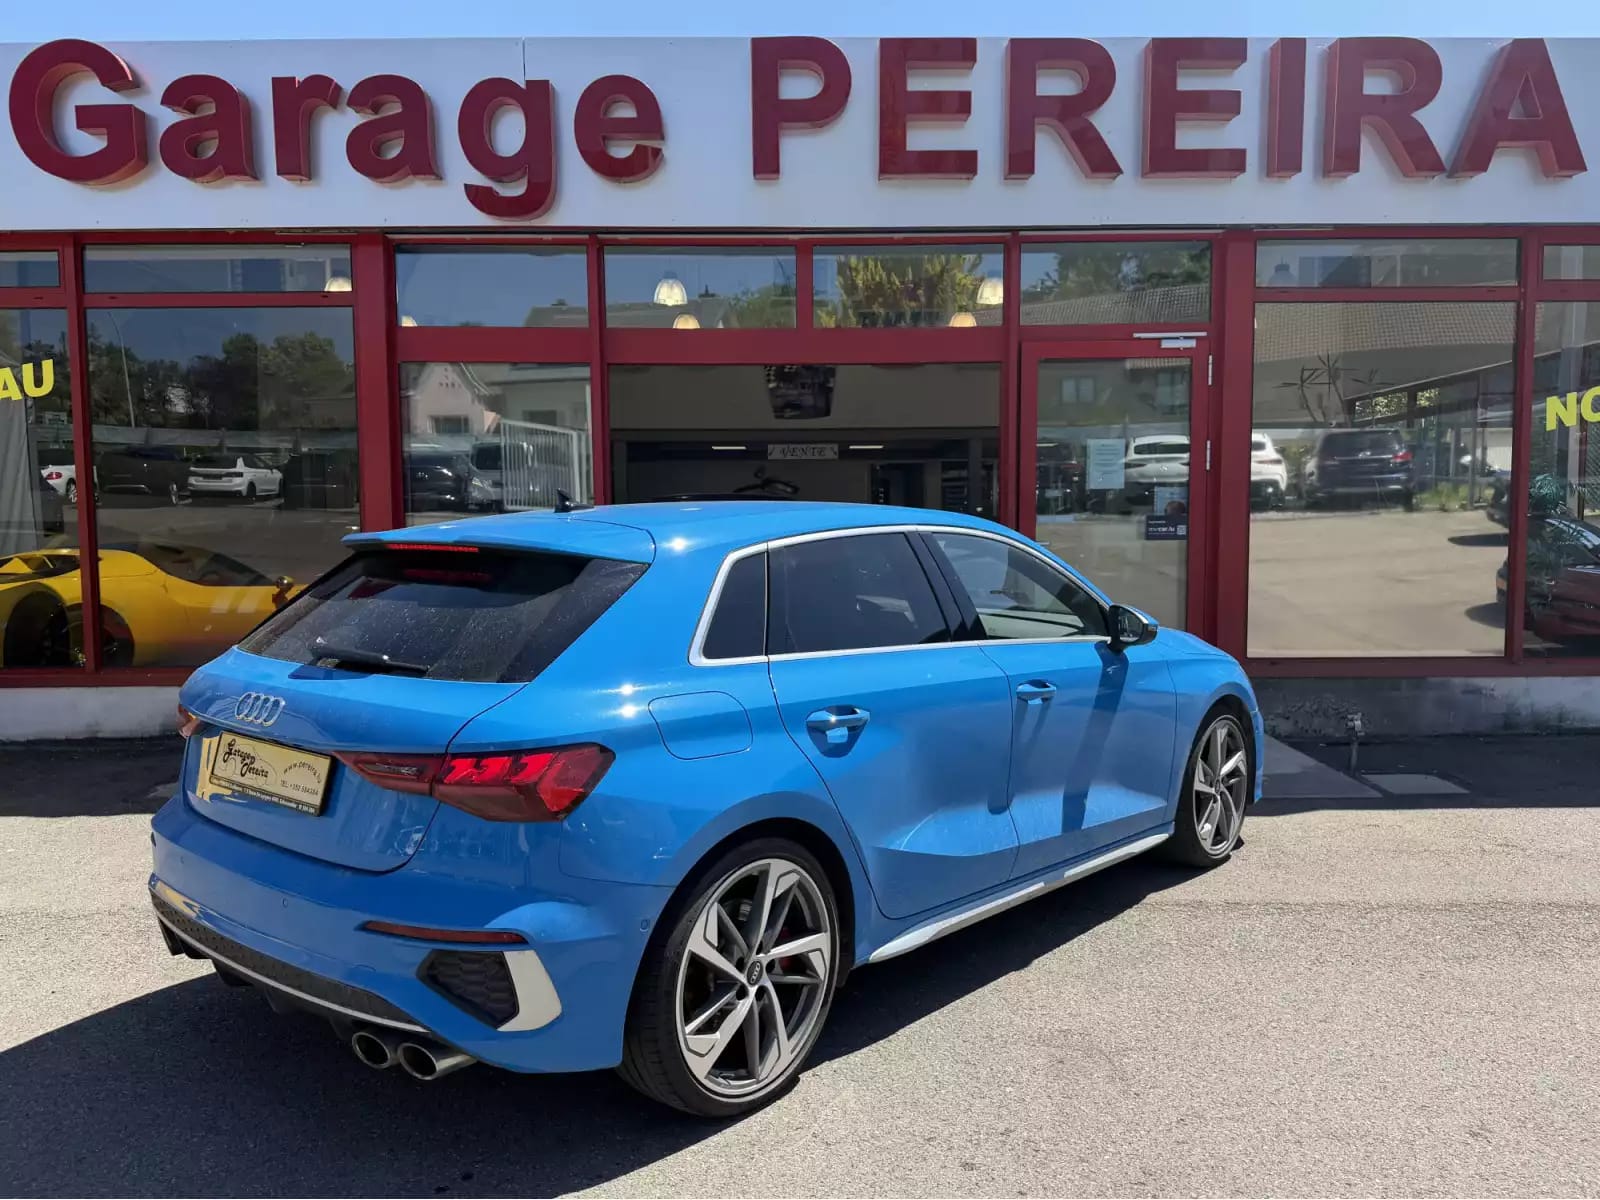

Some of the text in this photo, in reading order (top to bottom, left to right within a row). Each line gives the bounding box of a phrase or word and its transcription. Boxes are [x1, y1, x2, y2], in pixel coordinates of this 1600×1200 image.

[9, 36, 1588, 221] Garage PEREIRA
[780, 445, 827, 458] VENTE
[223, 738, 252, 764] Garage
[240, 756, 269, 778] Pereira
